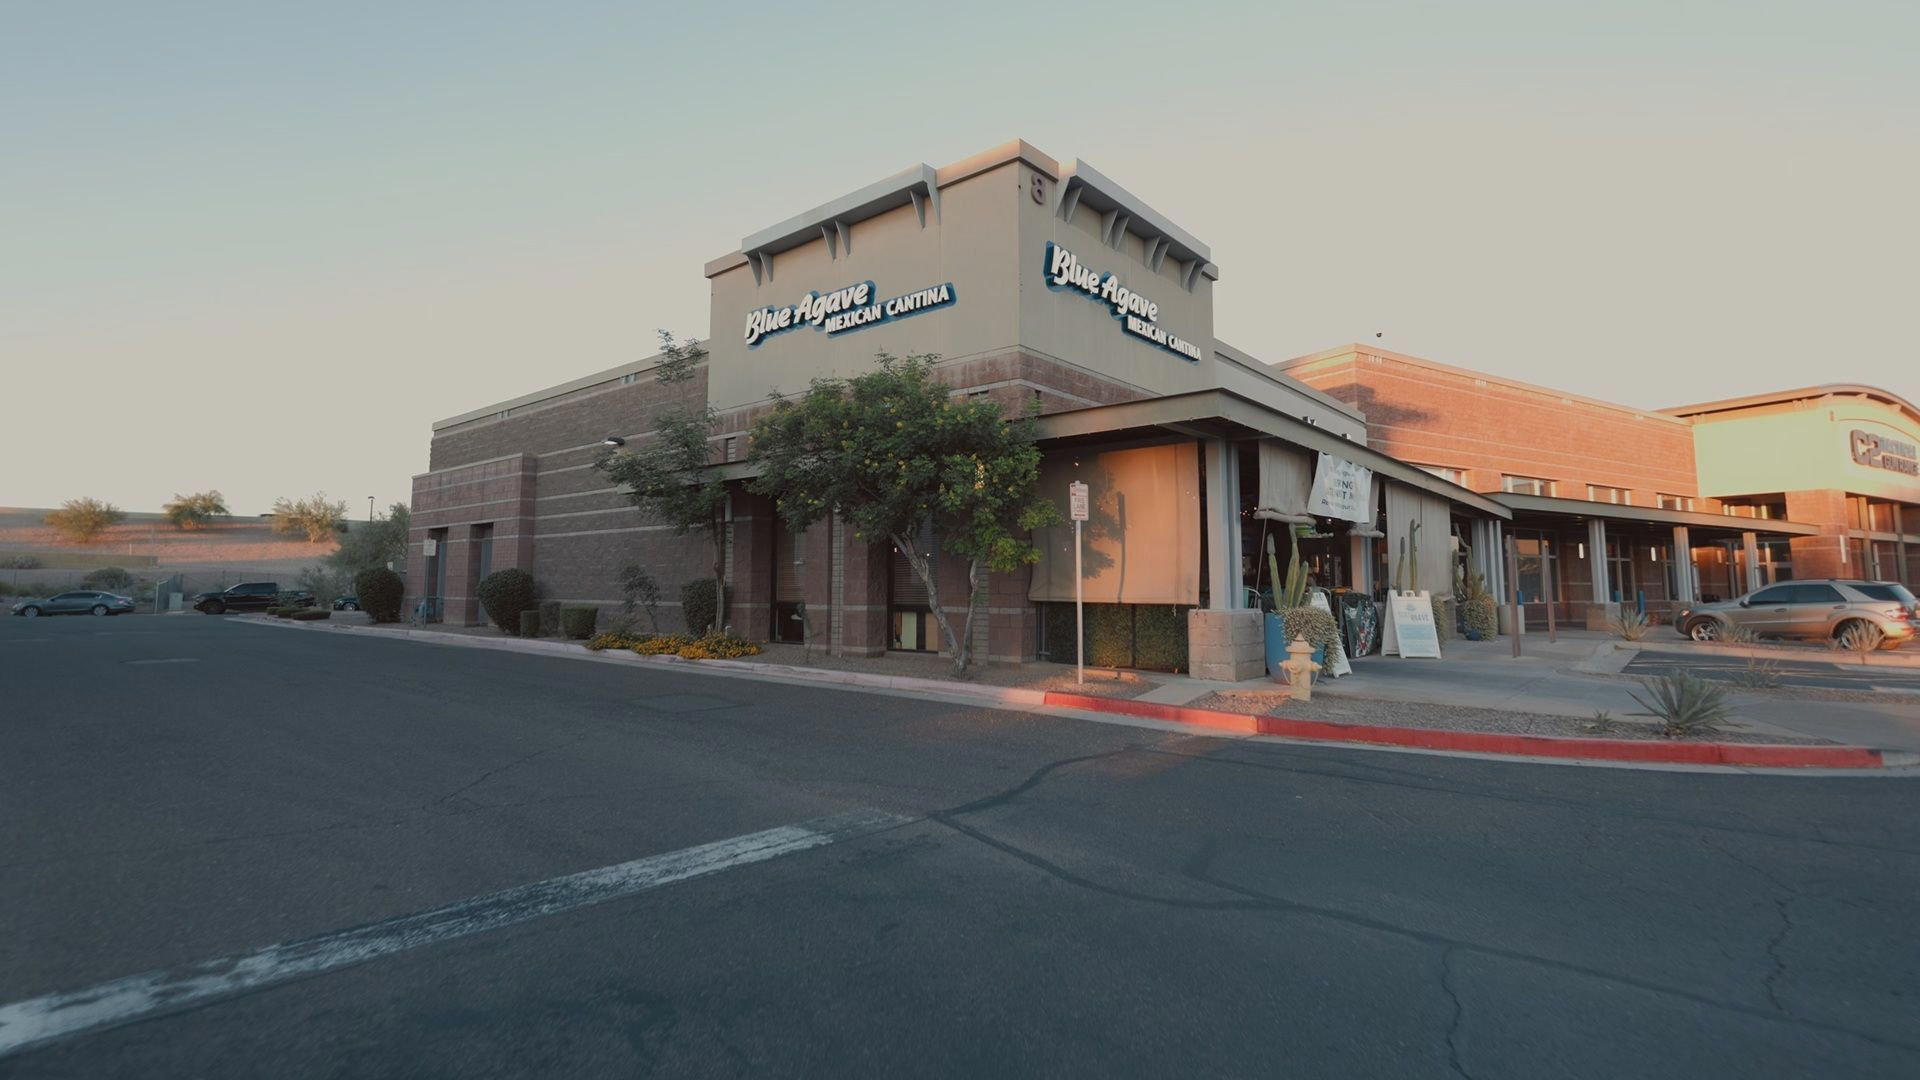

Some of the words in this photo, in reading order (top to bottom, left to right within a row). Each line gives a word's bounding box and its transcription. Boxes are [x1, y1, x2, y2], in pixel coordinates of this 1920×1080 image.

[1031, 172, 1046, 206] 8
[1051, 245, 1100, 294] Blue
[1101, 274, 1158, 322] Agave
[744, 306, 790, 345] Blue
[793, 283, 869, 326] Agave
[825, 303, 882, 333] MEXICAN
[886, 284, 950, 316] CANTINA
[1127, 315, 1167, 345] MEXICAN
[1168, 335, 1202, 360] CANTINA
[1850, 429, 1883, 468] C2
